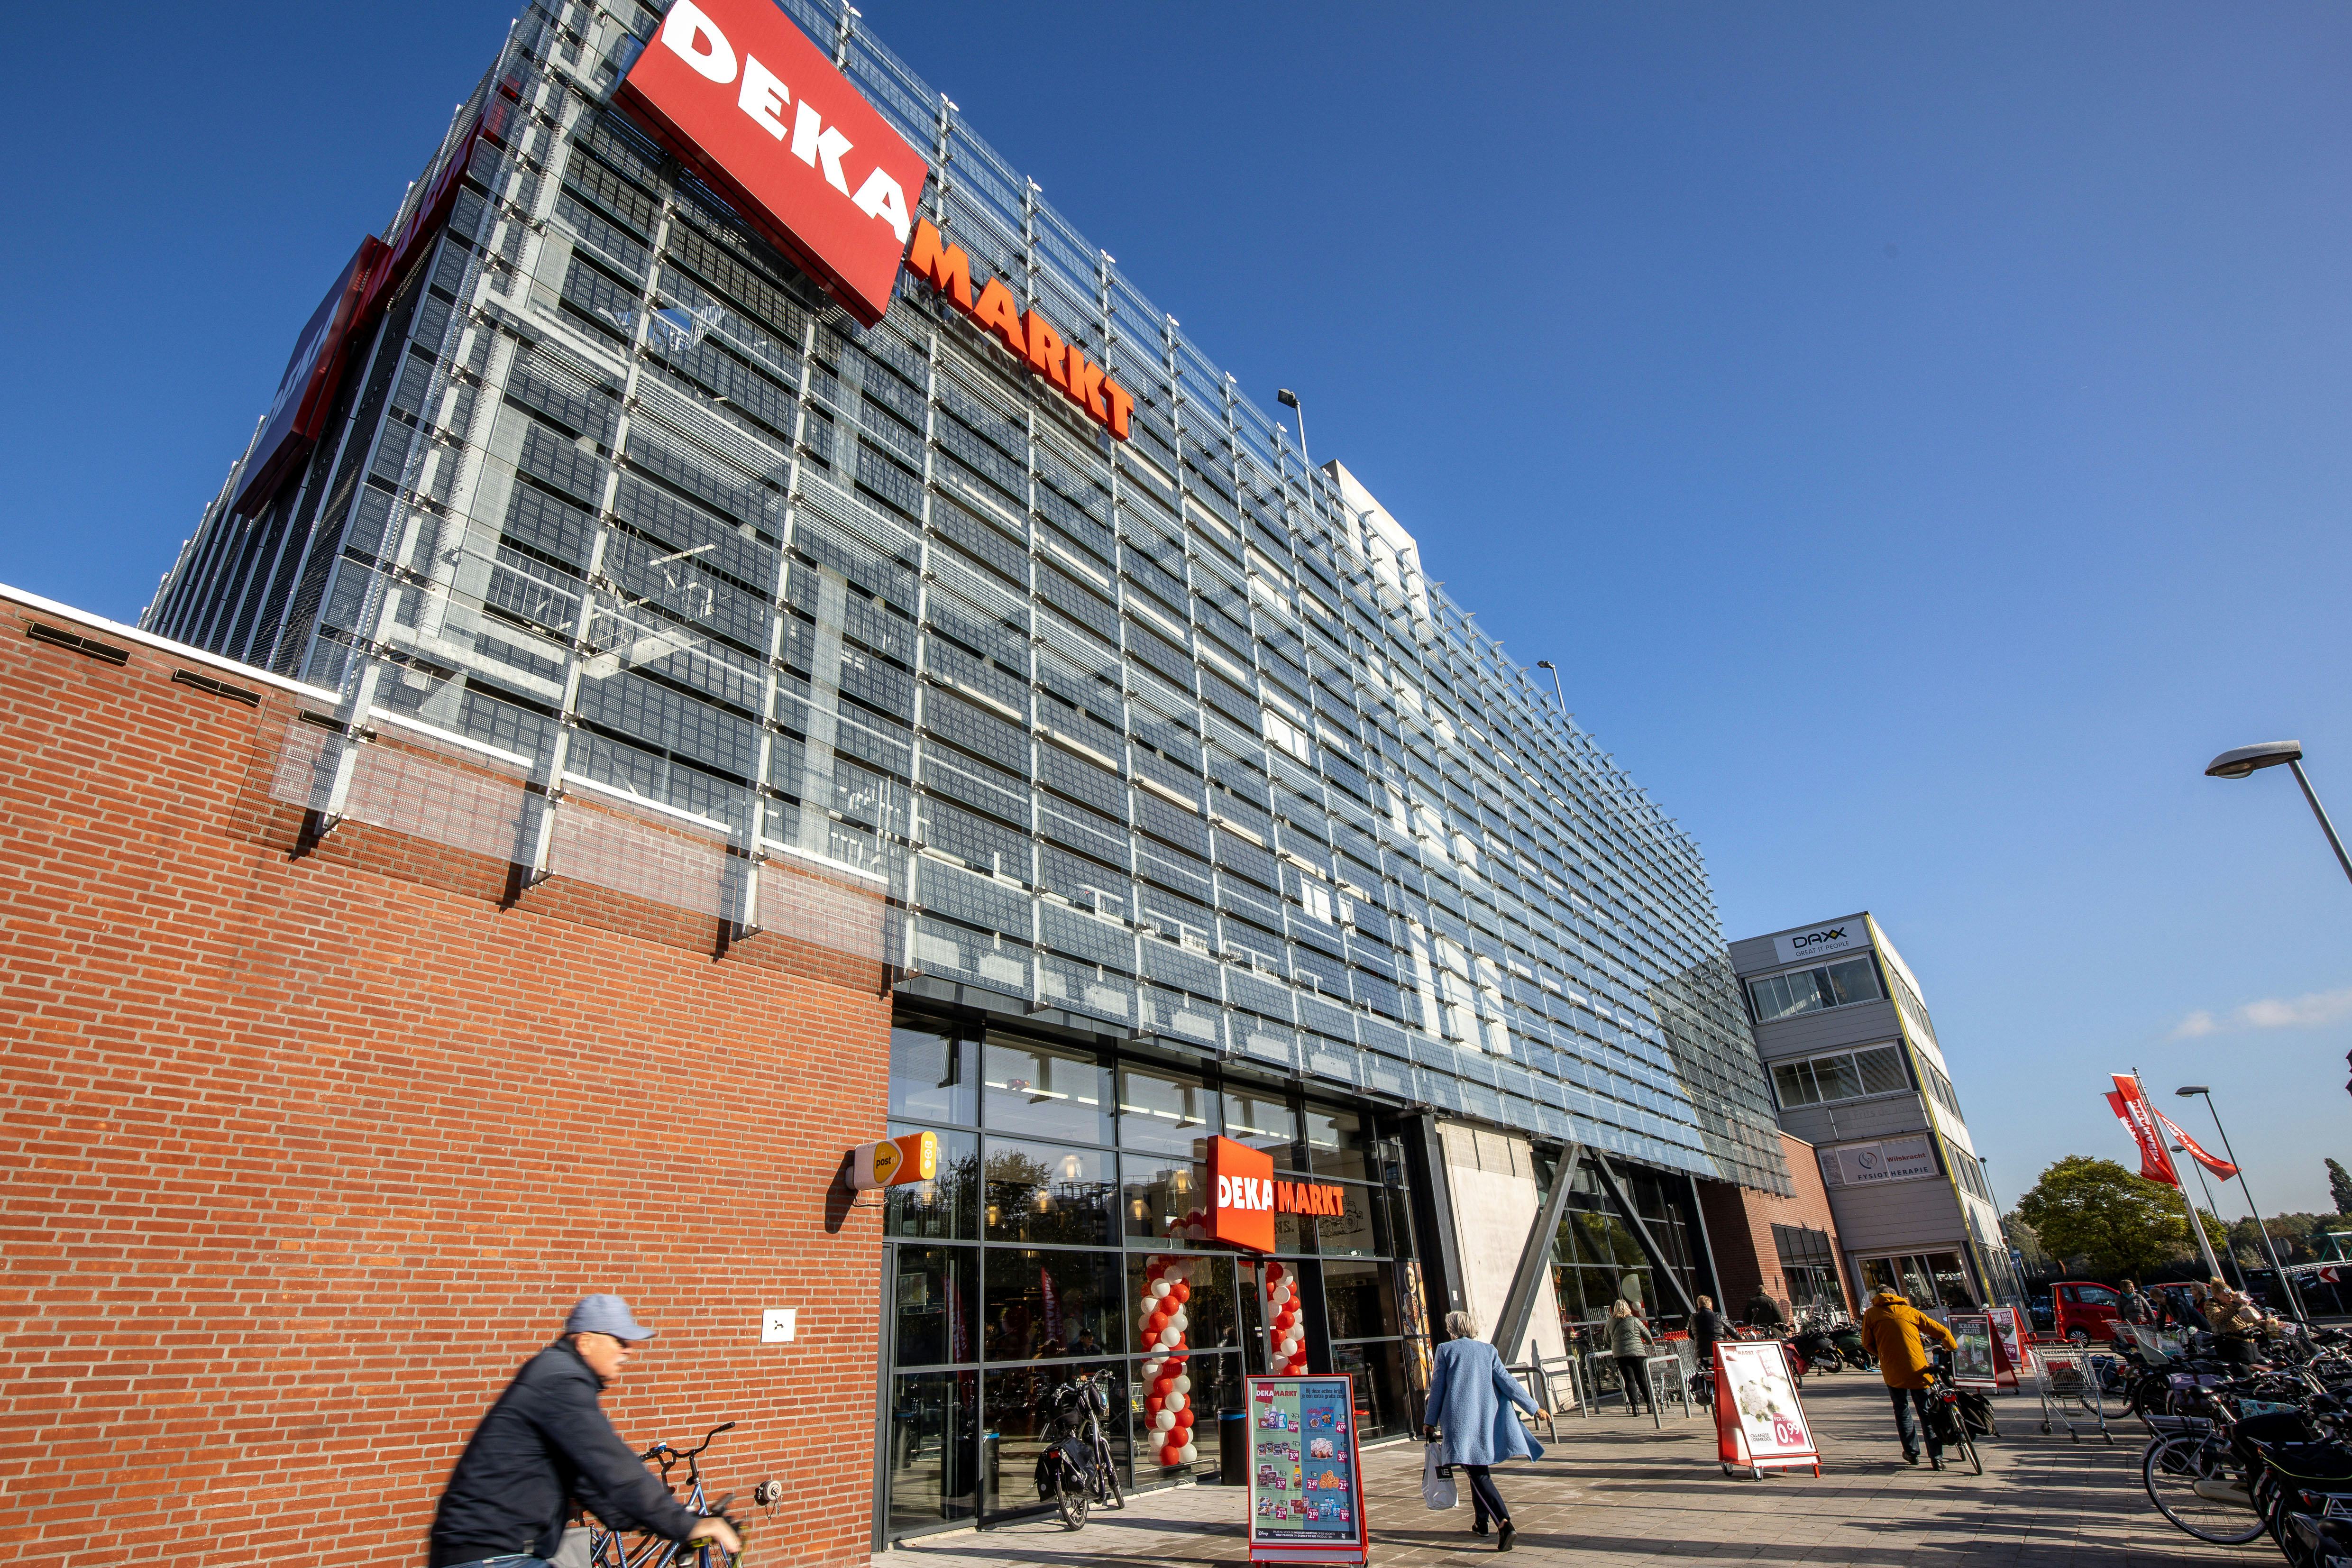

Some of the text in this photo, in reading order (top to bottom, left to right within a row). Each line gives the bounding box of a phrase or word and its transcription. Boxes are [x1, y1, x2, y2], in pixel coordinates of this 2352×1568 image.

[660, 0, 1134, 441] DEKA MARKT
[1792, 926, 1847, 949] DAXX
[1796, 948, 1817, 957] GREAT
[1826, 940, 1850, 951] PEOPLE
[1886, 1153, 1927, 1162] Wilskracht
[1858, 1167, 1929, 1180] FYSIOTHERAPIE
[1218, 1174, 1344, 1216] DEKA MARKT
[1776, 1422, 1800, 1444] 0.99
